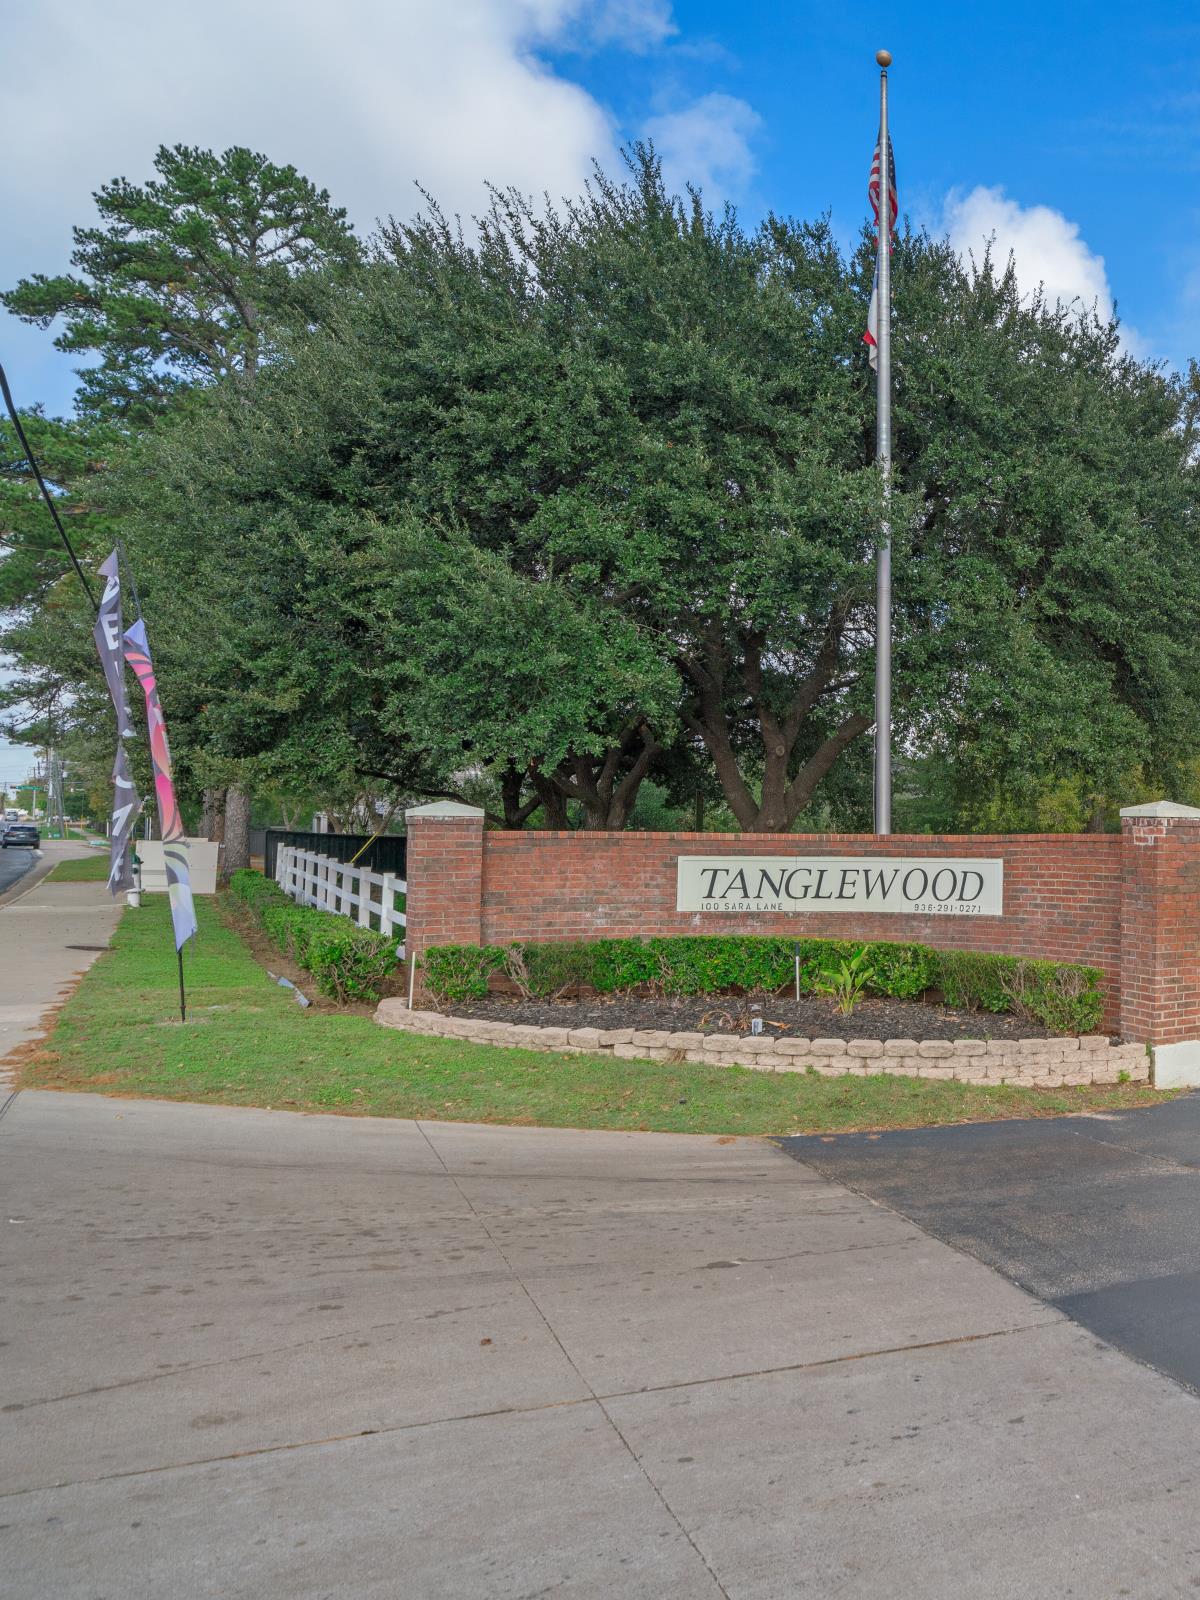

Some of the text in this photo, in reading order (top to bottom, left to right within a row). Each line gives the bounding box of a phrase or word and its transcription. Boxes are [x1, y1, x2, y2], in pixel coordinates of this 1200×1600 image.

[700, 868, 984, 902] TANGLEWOOD
[701, 902, 783, 911] 100 SARA LANE
